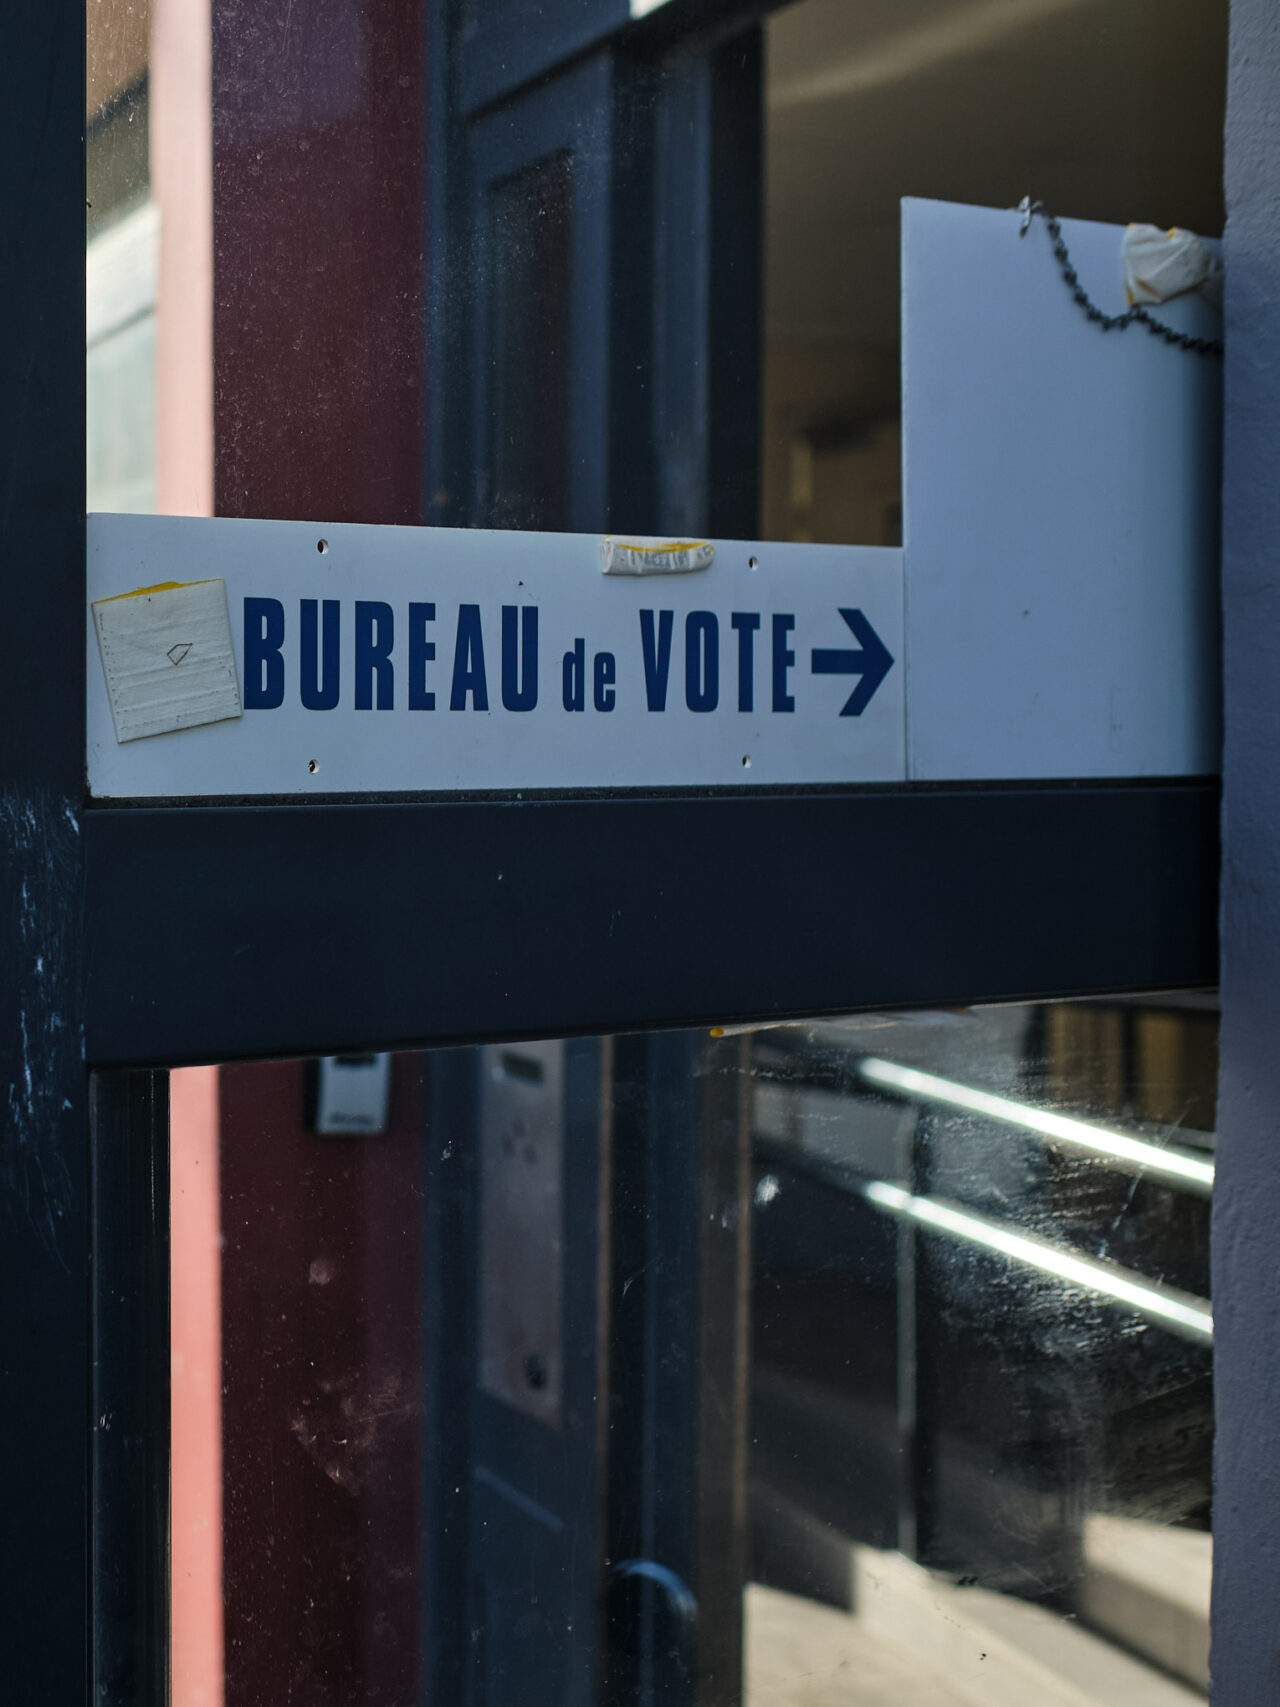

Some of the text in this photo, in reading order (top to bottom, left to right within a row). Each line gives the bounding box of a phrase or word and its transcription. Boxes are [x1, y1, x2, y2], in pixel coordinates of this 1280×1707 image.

[243, 596, 796, 713] BUREAU de VOTE
